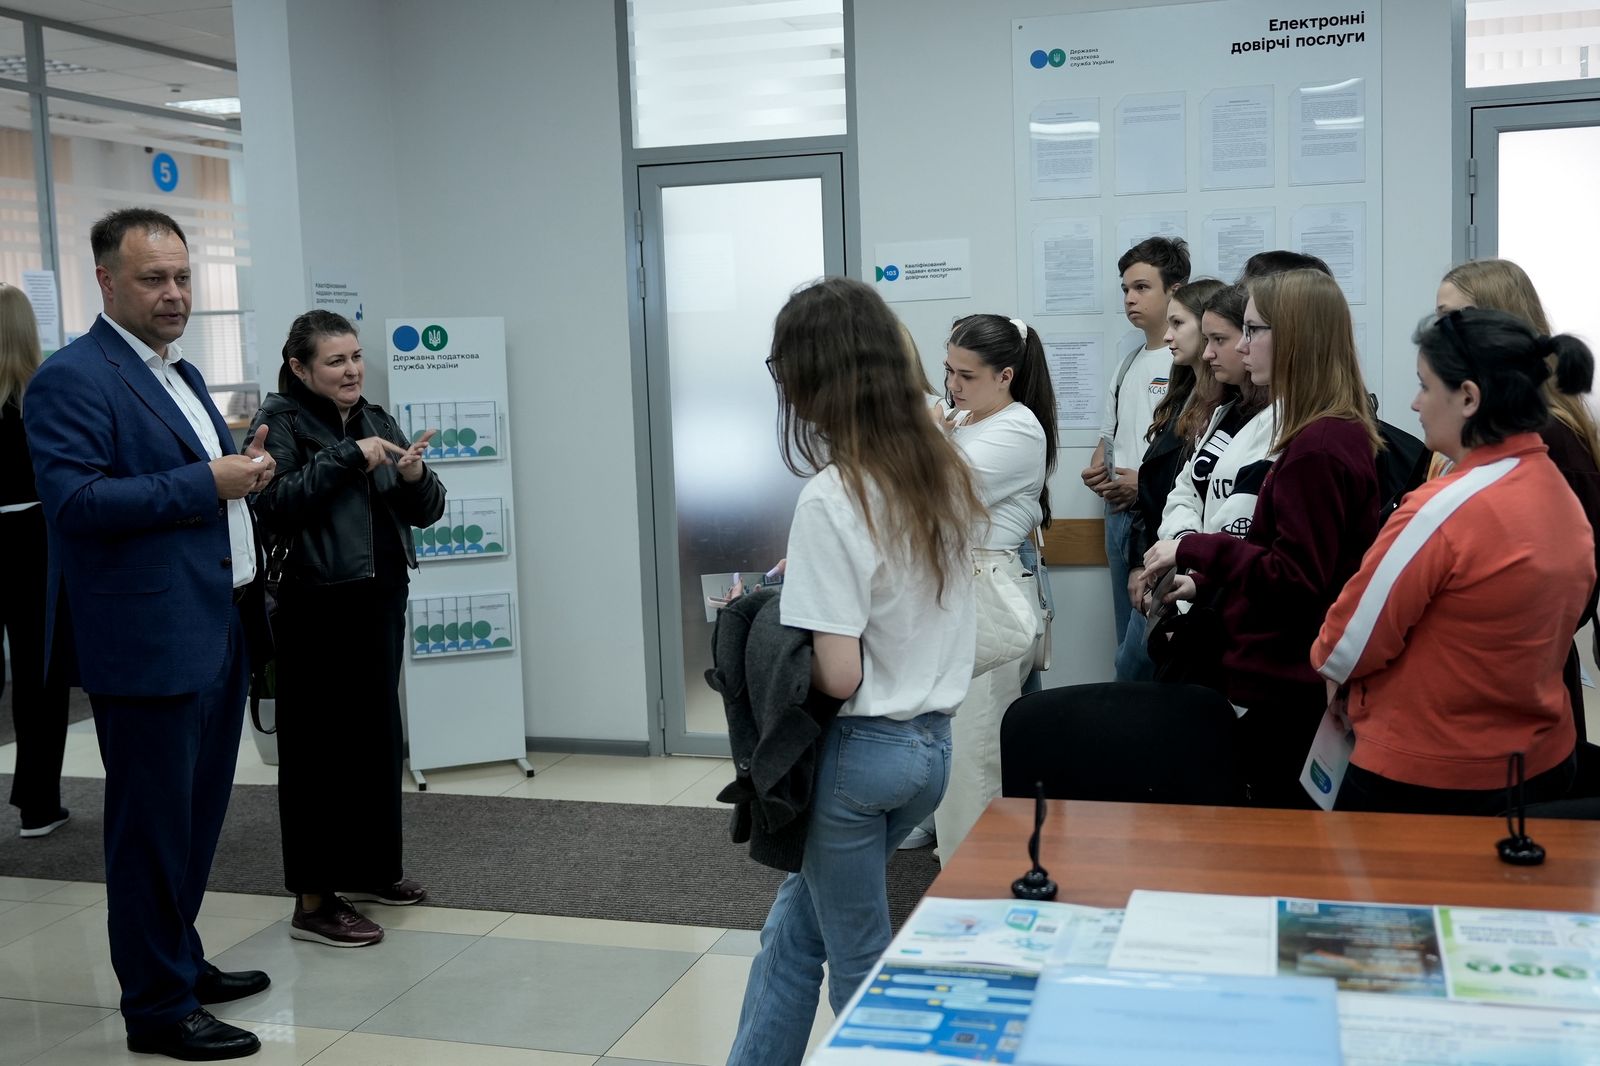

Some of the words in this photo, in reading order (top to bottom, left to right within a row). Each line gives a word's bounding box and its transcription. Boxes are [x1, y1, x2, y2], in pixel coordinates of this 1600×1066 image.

[1269, 11, 1365, 31] Електронні
[1231, 35, 1290, 54] довірчі
[1296, 32, 1365, 47] послуги
[160, 162, 171, 184] 5
[393, 354, 435, 362] Державна
[437, 353, 480, 361] податкова
[393, 363, 425, 371] служба
[427, 361, 458, 370] України
